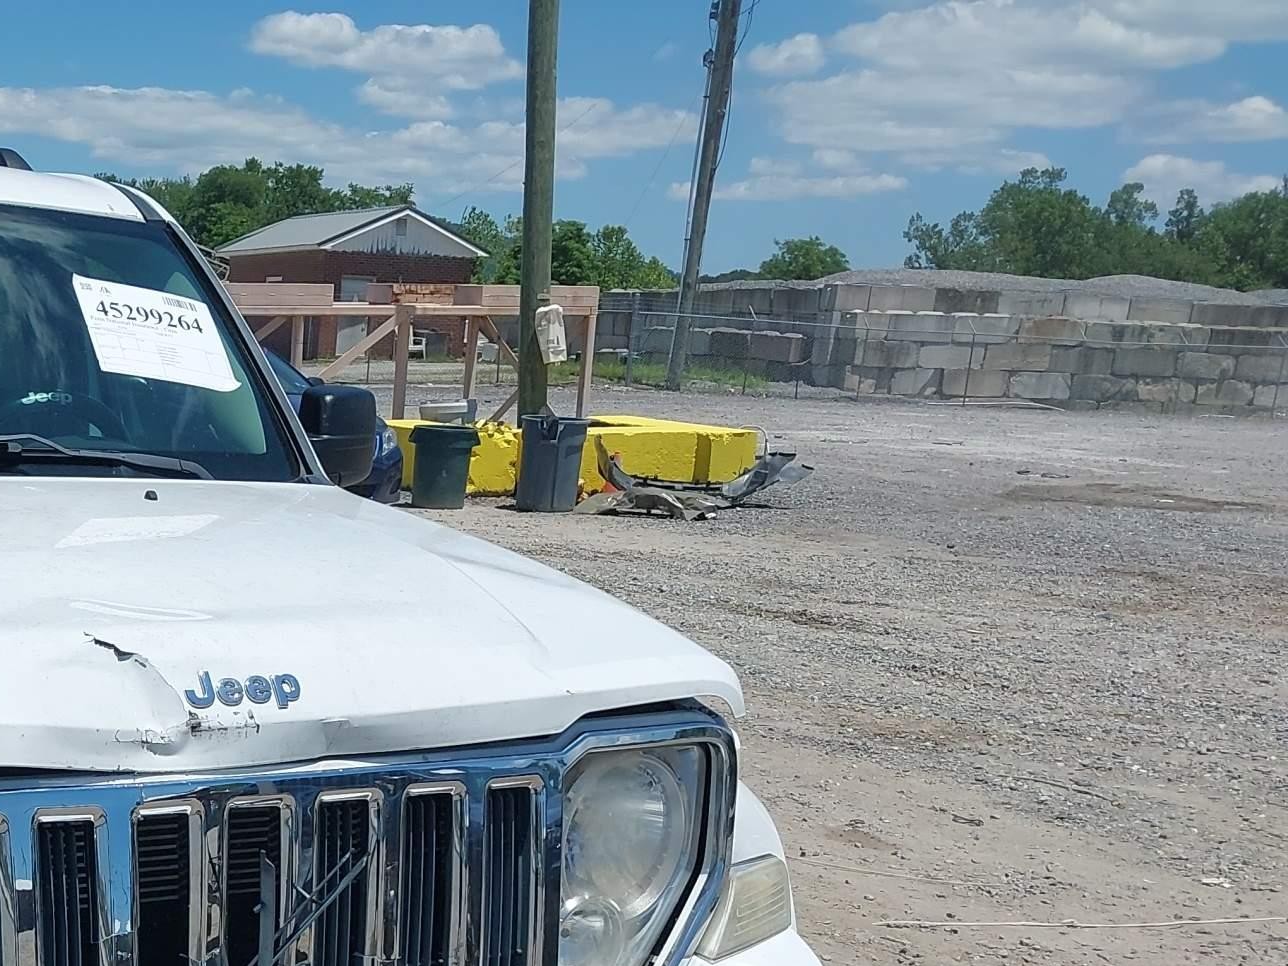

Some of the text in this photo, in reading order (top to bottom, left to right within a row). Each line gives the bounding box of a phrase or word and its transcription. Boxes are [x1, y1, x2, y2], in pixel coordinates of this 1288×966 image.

[96, 300, 203, 334] 45299264
[21, 391, 73, 404] Jeep
[184, 670, 301, 710] Jeep
